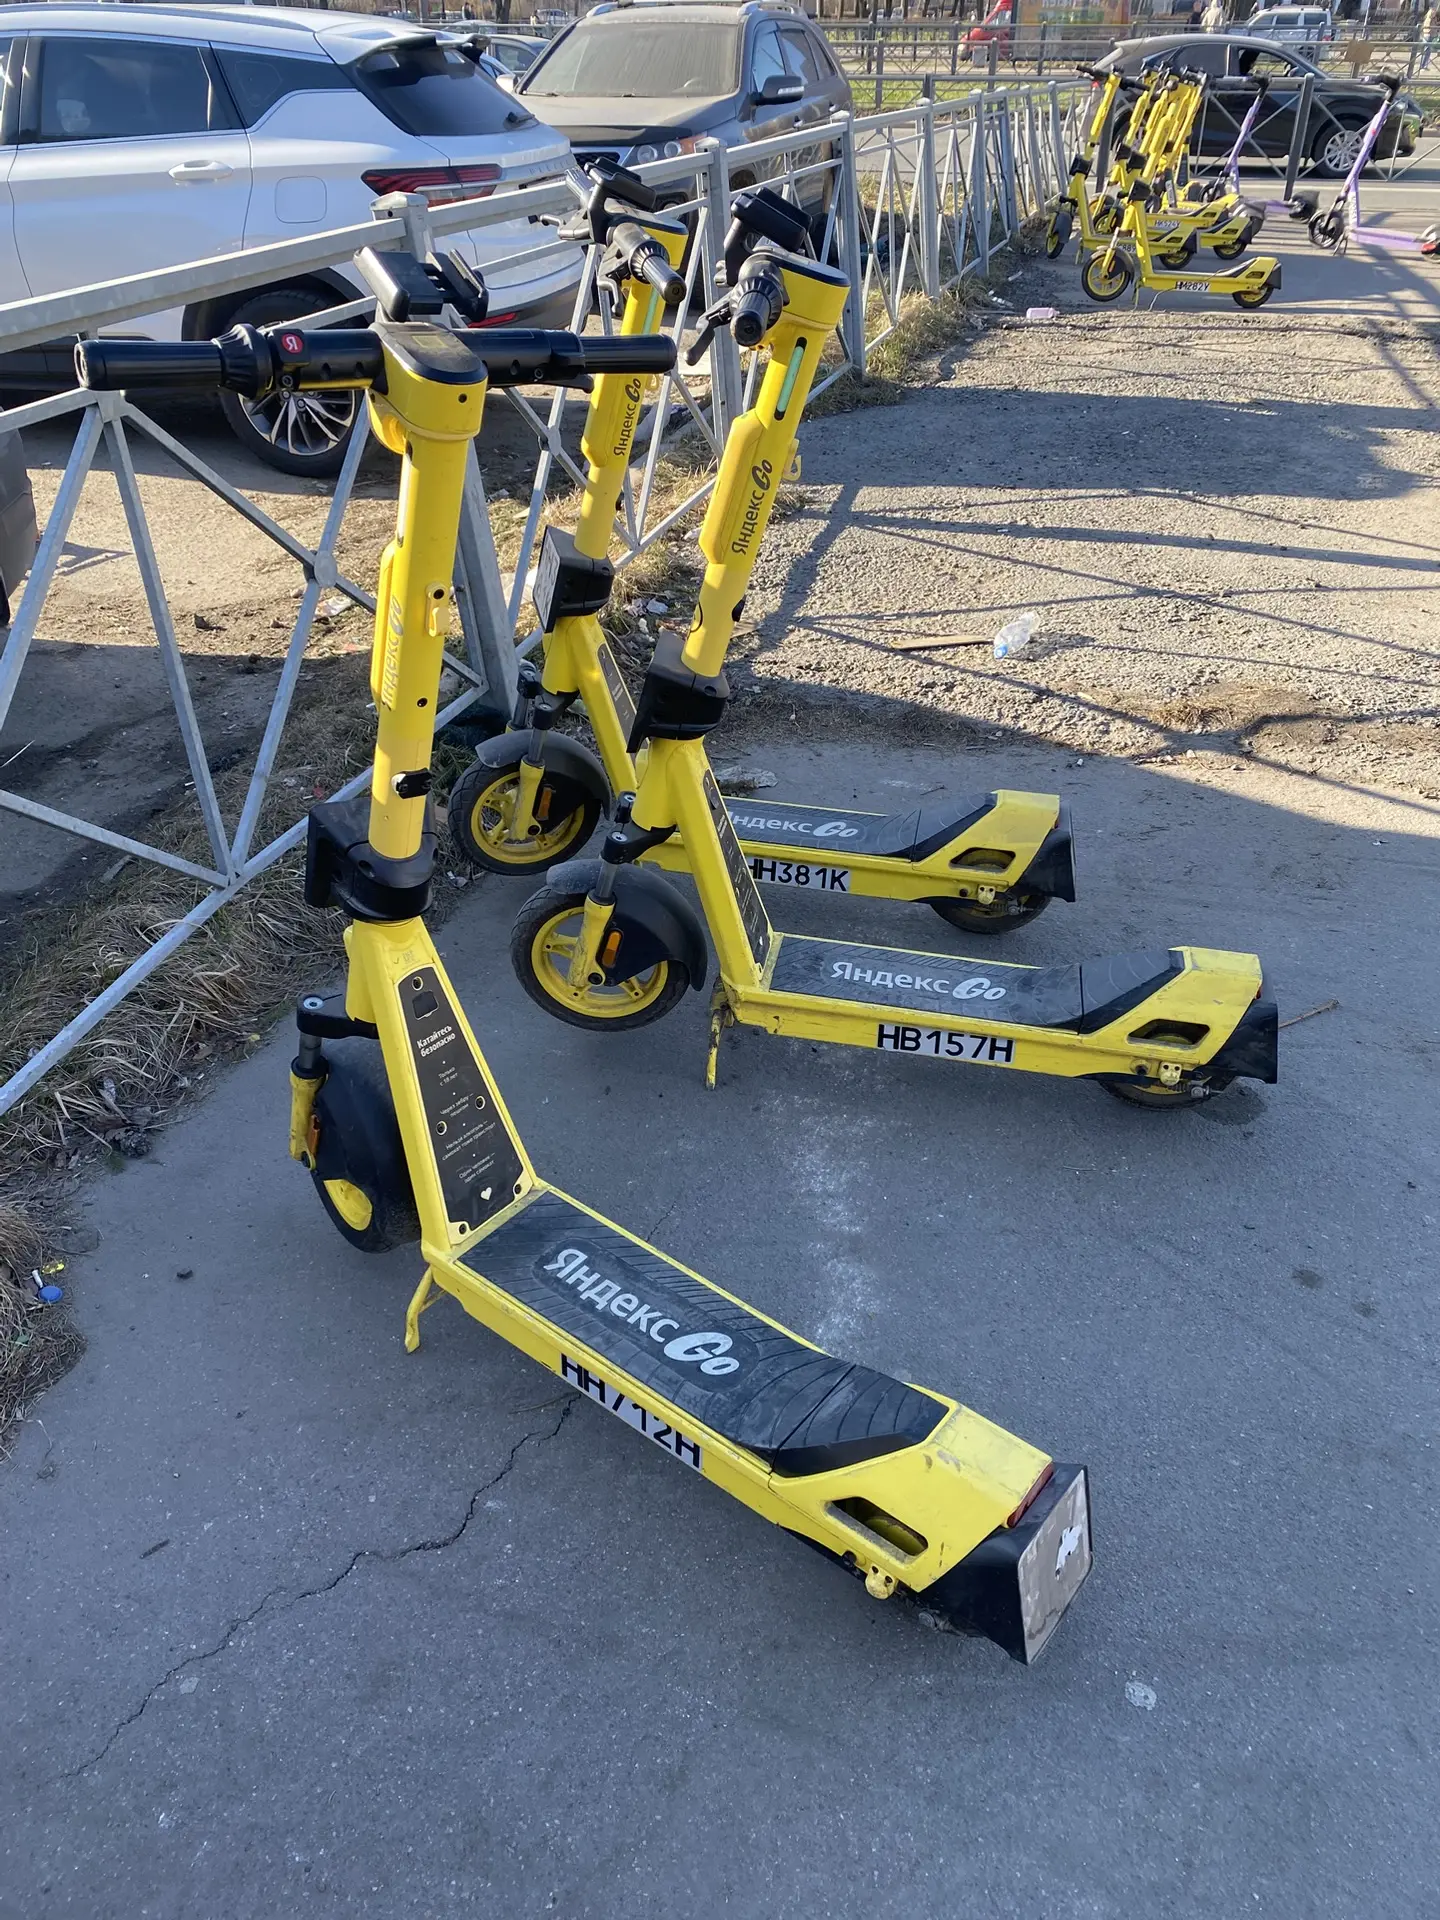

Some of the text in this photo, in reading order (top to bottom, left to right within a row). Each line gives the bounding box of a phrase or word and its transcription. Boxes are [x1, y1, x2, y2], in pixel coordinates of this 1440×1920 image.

[613, 378, 642, 457] Яндекс Go
[731, 459, 773, 555] Яндекс Go
[812, 821, 859, 838] Go
[830, 961, 1007, 1000] Яндекс Go
[417, 1025, 452, 1049] Катайтесь
[420, 1033, 456, 1057] безопасно
[877, 1024, 1014, 1062] НВ157Н
[543, 1248, 740, 1375] Яндекс Go
